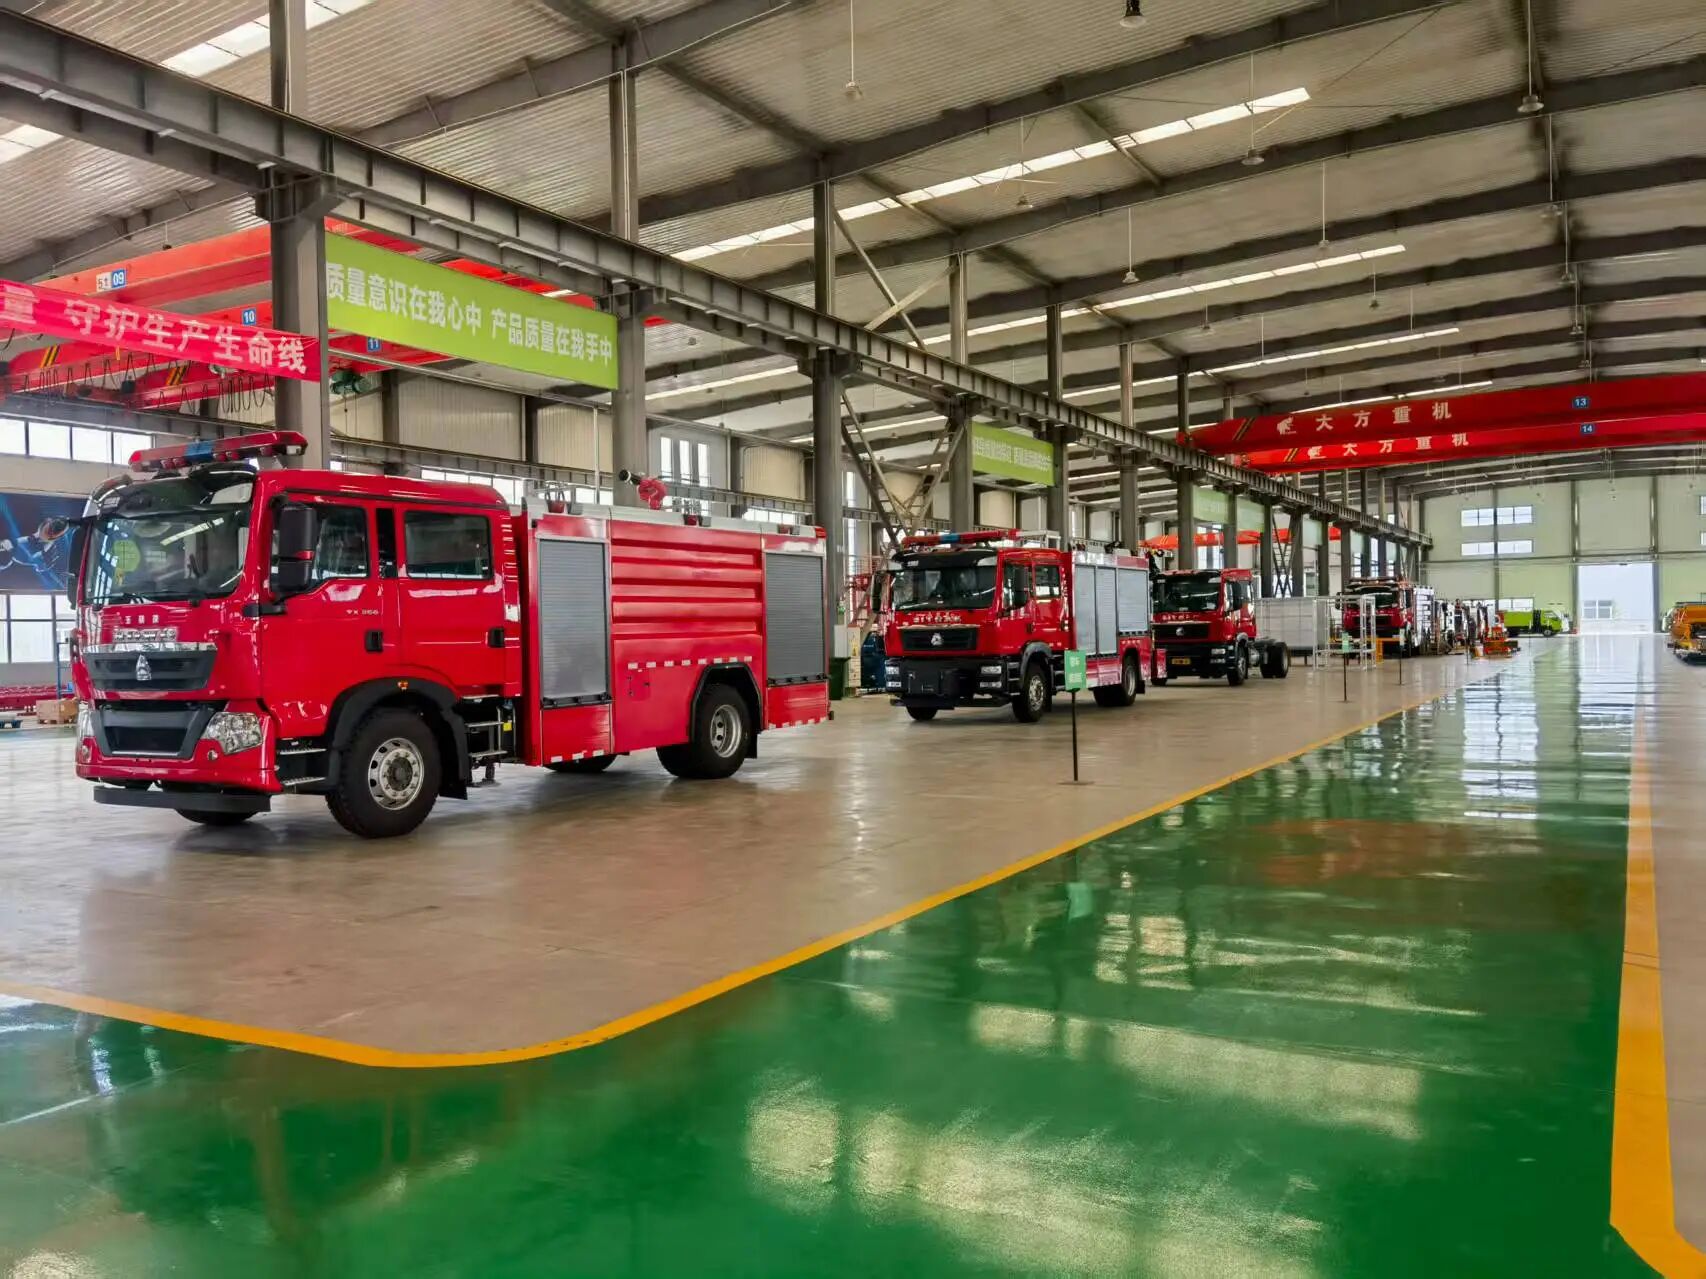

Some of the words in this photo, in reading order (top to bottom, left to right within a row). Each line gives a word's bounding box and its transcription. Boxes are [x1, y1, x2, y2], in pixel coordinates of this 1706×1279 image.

[113, 271, 125, 286] 09
[243, 311, 255, 324] 10
[325, 261, 482, 337] 质量意识在我心中
[491, 307, 613, 368] 产品质量在我手中
[63, 298, 307, 375] 守护生产生命线
[368, 338, 380, 350] 11
[1574, 398, 1587, 408] 13
[1315, 401, 1453, 432] 大方重机
[1581, 424, 1593, 434] 14
[1342, 432, 1469, 458] 大方重机
